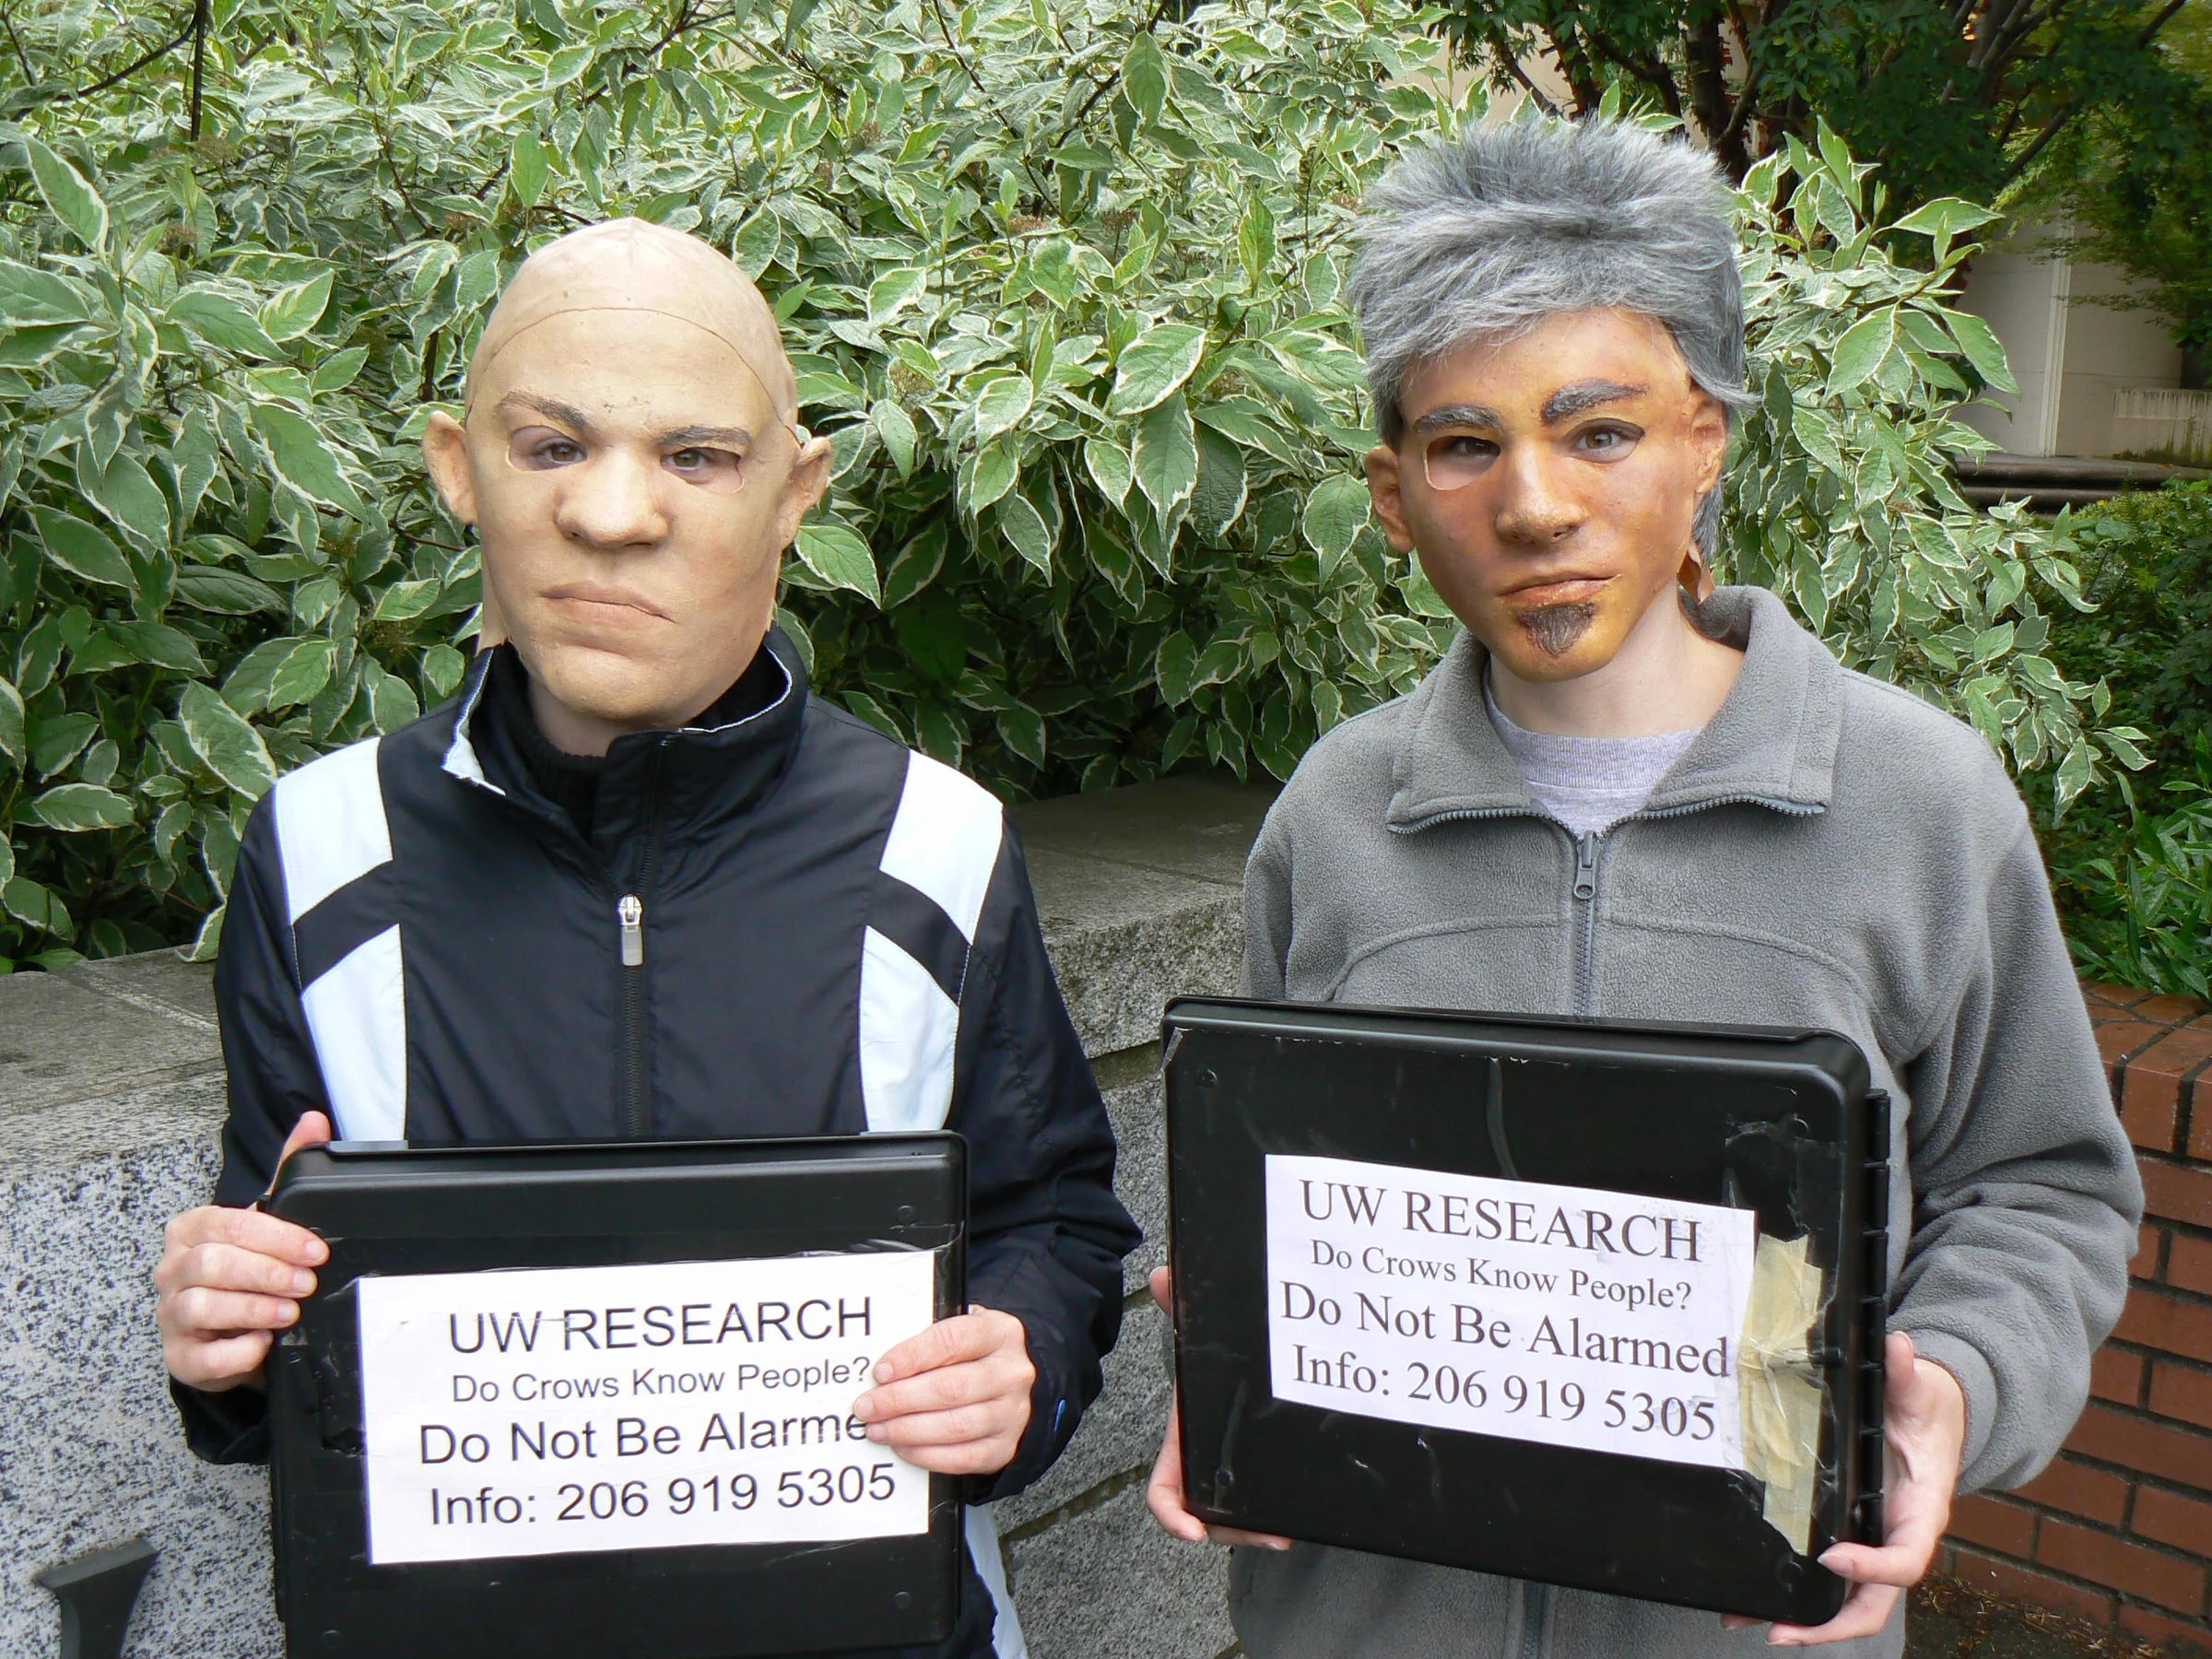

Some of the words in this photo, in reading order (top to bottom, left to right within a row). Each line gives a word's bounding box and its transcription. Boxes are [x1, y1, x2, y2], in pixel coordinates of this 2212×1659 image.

[1300, 1180, 1386, 1226] UW
[1402, 1190, 1702, 1262] RESEARCH
[1311, 1239, 1352, 1269] Do
[1360, 1247, 1456, 1282] Crows
[1467, 1257, 1554, 1293] Know
[1570, 1269, 1691, 1312] People?
[451, 1312, 541, 1353] UW
[564, 1298, 870, 1350] RESEARCH
[1280, 1281, 1342, 1325] Do
[1354, 1292, 1436, 1339] Not
[1451, 1304, 1511, 1348] Be
[1526, 1315, 1731, 1378] Alarmed
[453, 1375, 499, 1401] Do
[513, 1374, 618, 1400] Crows
[634, 1369, 724, 1394] Know
[739, 1357, 869, 1392] People?
[1292, 1344, 1389, 1395] Info:
[1406, 1361, 1488, 1408] 206
[1501, 1375, 1585, 1421] 919
[1602, 1389, 1714, 1441] 5305
[421, 1425, 489, 1464] Do
[512, 1422, 596, 1461] Not
[618, 1418, 680, 1456] Be
[700, 1412, 867, 1452] Alarme
[432, 1488, 535, 1524] Info:
[558, 1481, 648, 1520] 206
[668, 1475, 757, 1514] 919
[778, 1464, 894, 1508] 5305
